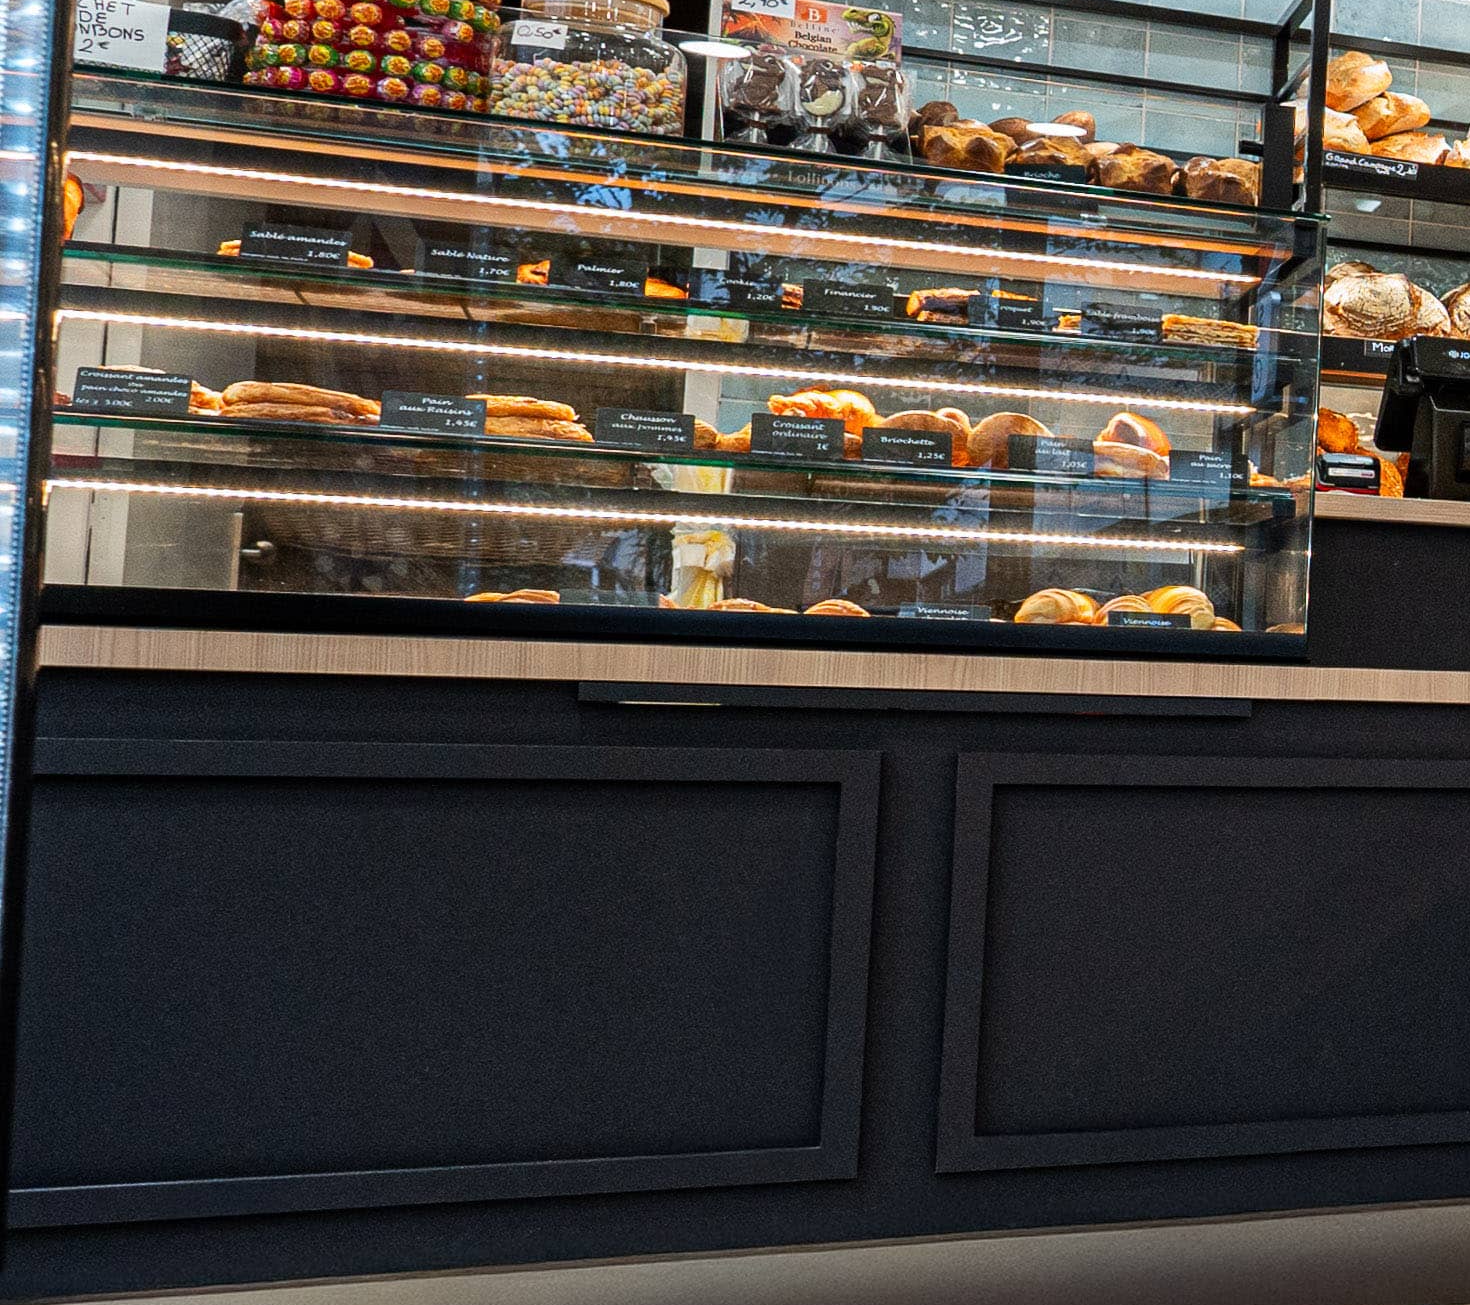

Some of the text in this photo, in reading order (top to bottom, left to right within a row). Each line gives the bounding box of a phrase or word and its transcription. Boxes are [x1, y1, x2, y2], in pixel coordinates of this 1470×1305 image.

[78, 10, 108, 25] DE
[807, 7, 821, 22] B
[794, 30, 833, 44] Belgian
[77, 38, 110, 54] 2€
[787, 39, 839, 55] Chocolate
[286, 234, 349, 248] amandes
[577, 263, 626, 275] Palmier
[824, 288, 877, 300] Financier
[80, 370, 189, 384] Croissant amandes
[81, 384, 108, 392] pain
[139, 389, 189, 398] amandes
[421, 396, 454, 407] Pain
[398, 404, 474, 417] aux Raisins
[620, 412, 677, 424] Chausson
[772, 420, 826, 432] Croissant
[771, 430, 829, 440] ordinaire
[880, 435, 936, 447] Briochette
[816, 442, 830, 452] 1€
[916, 606, 969, 616] Viennoise
[1122, 617, 1173, 626] Viennoise
